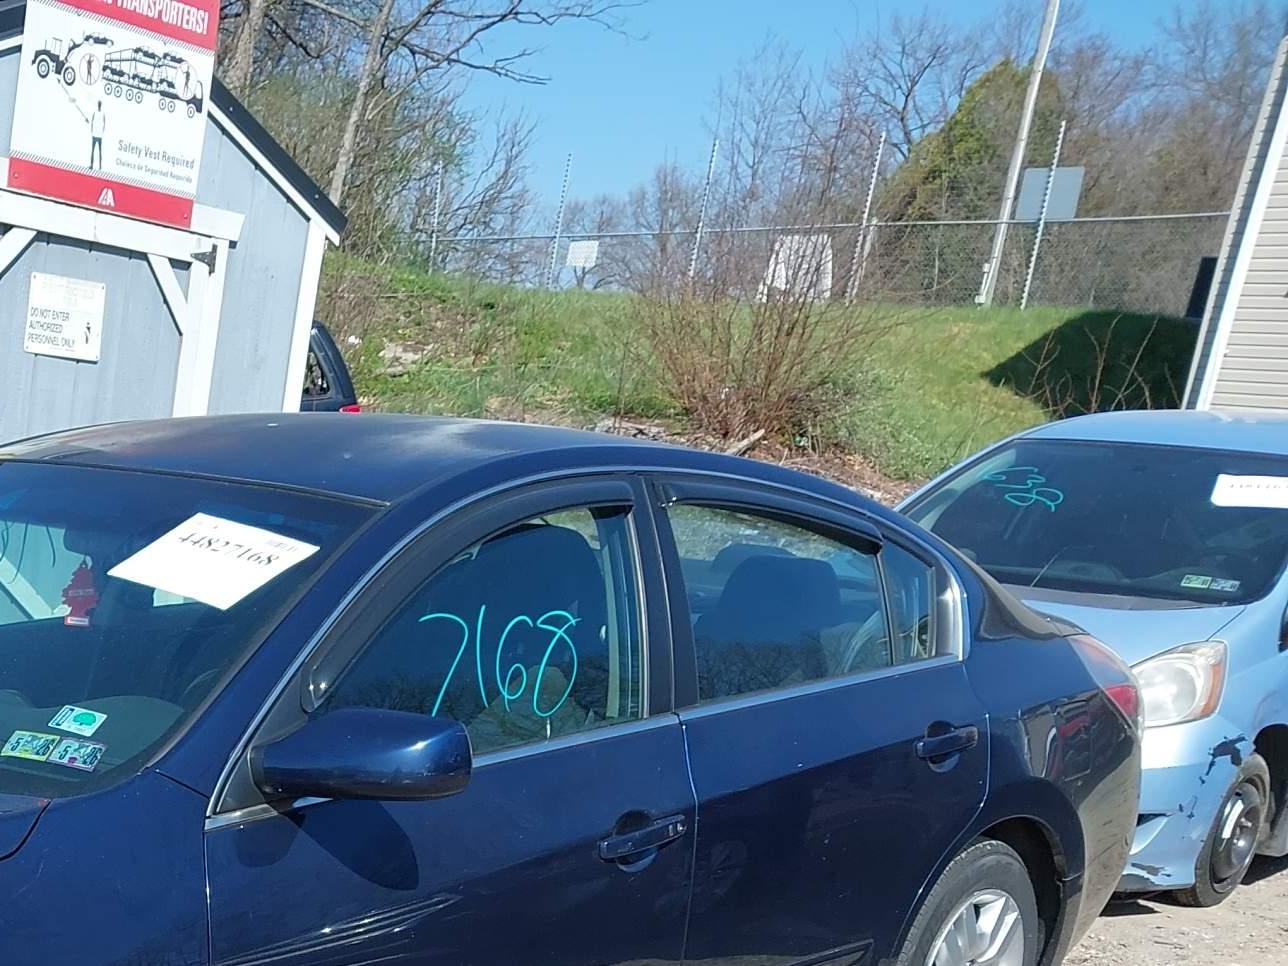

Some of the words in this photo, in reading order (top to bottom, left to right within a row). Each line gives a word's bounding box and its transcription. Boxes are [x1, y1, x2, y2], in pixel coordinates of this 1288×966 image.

[117, 139, 142, 158] Safety
[144, 145, 160, 161] Vest
[162, 151, 195, 169] Required
[40, 308, 51, 319] NOT
[52, 310, 70, 321] ENTER
[28, 319, 63, 333] AUTHORIZED
[27, 332, 60, 346] PERSONNEL
[179, 532, 279, 565] 44827168
[418, 604, 582, 718] 7168
